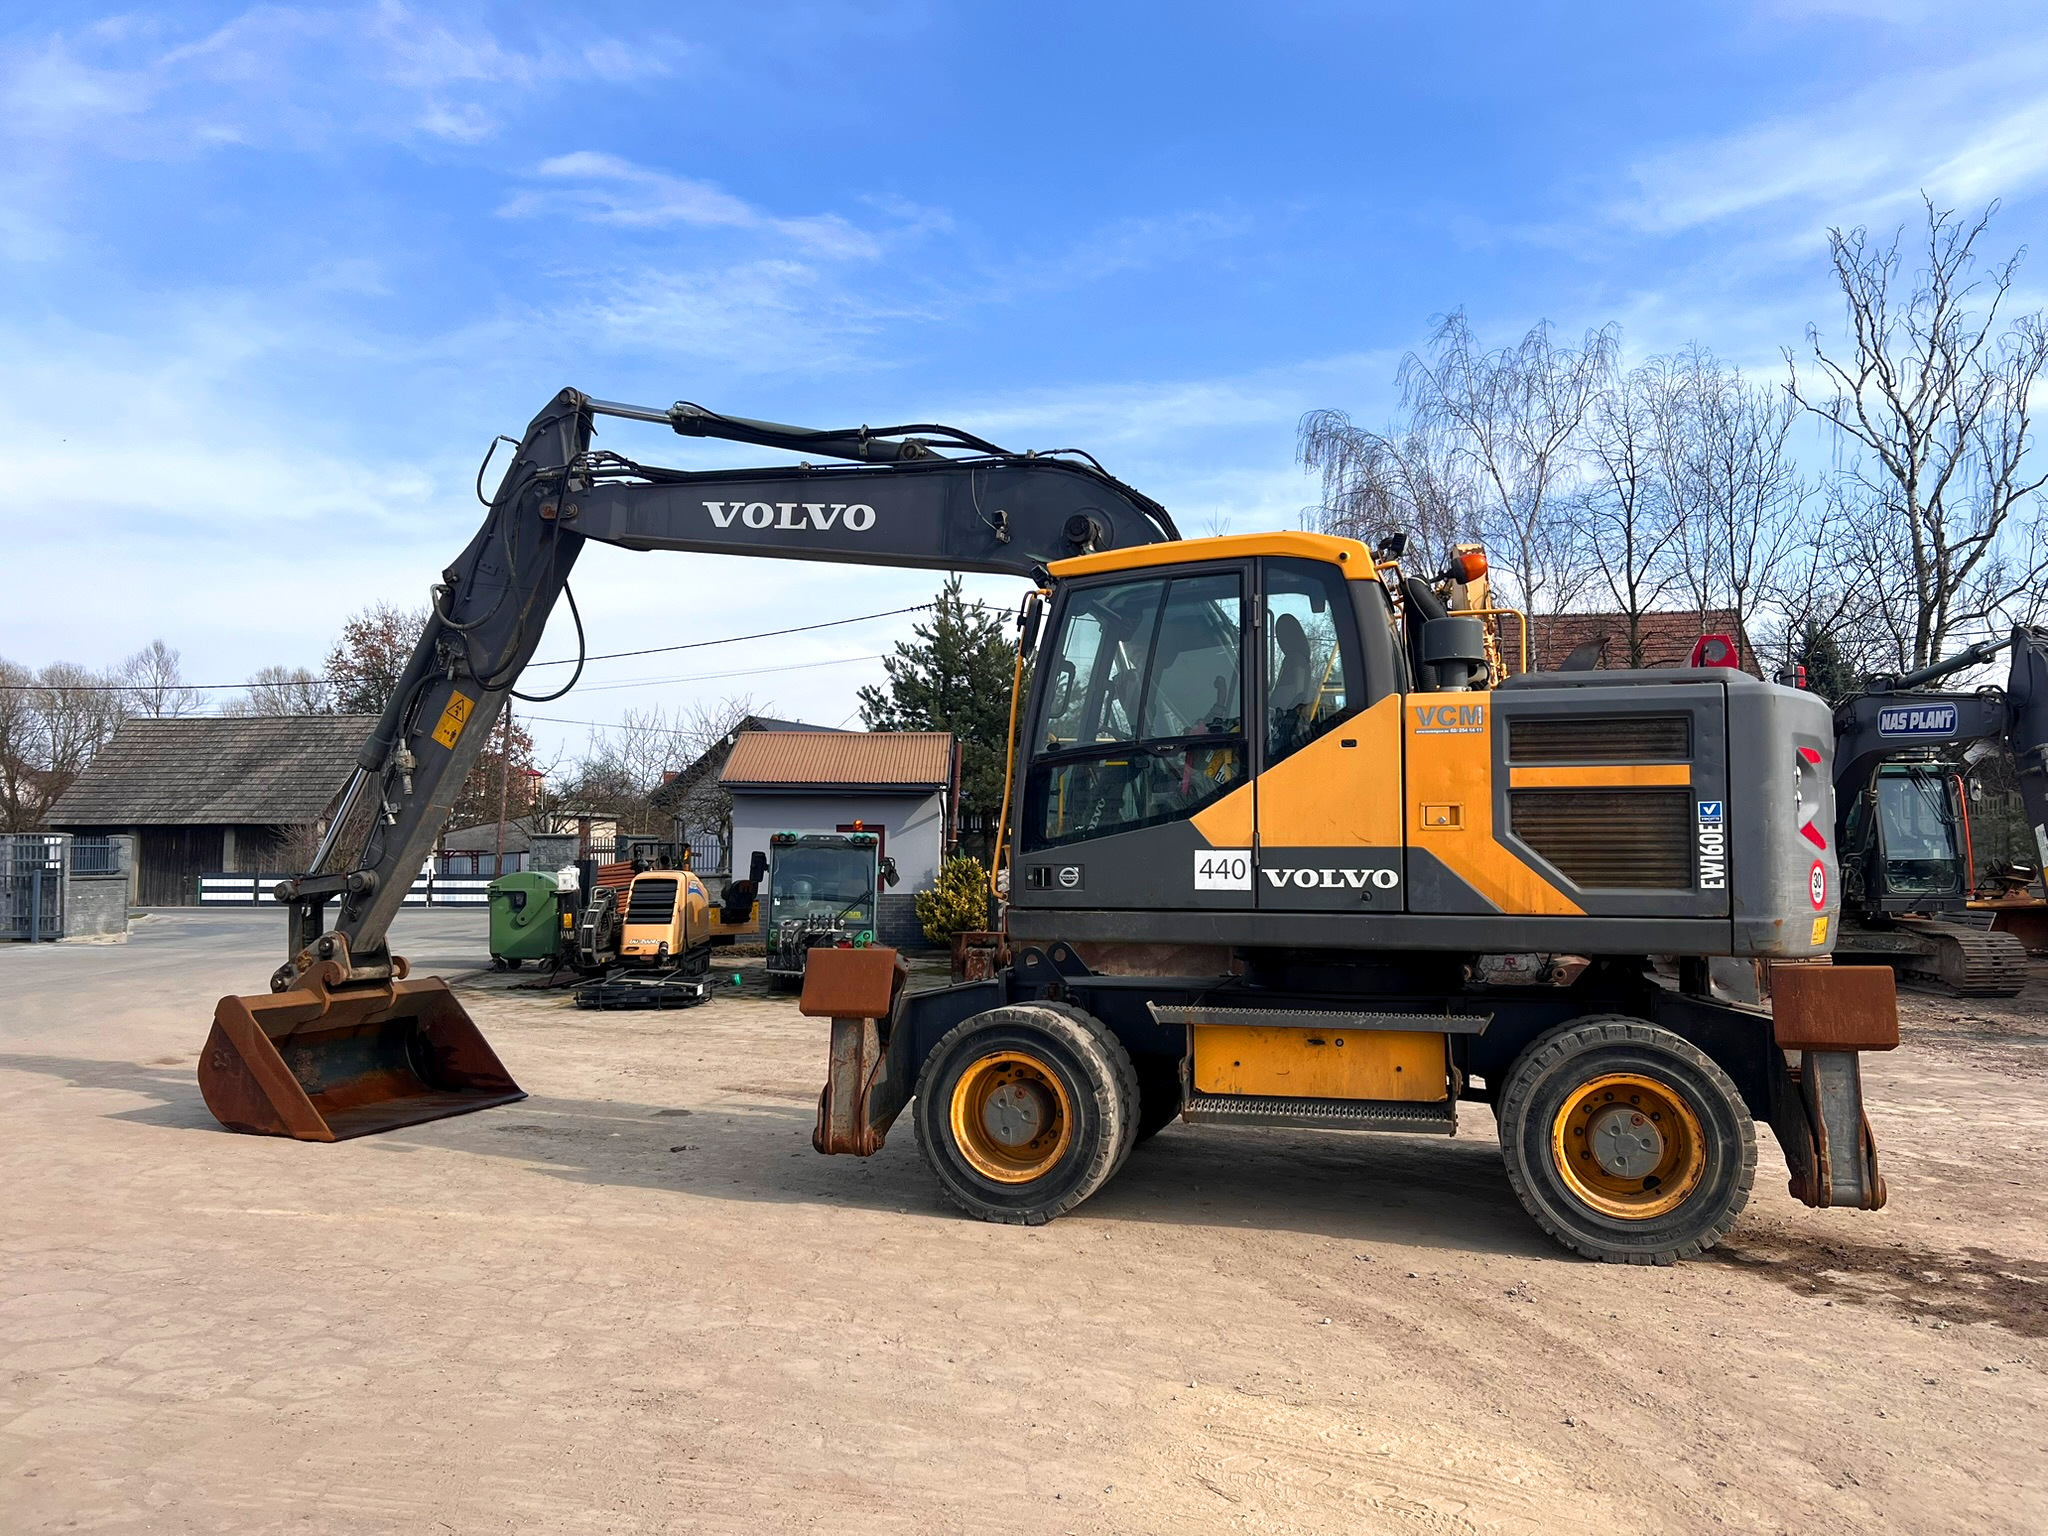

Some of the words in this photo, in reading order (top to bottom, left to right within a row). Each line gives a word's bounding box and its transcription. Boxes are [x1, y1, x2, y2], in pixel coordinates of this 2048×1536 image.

[702, 502, 876, 531] VOLVO
[1415, 705, 1483, 727] VCM
[1881, 712, 1908, 731] NAS
[1909, 709, 1954, 730] PLANT
[1699, 823, 1725, 889] EW160E
[1199, 858, 1246, 880] 440
[1262, 868, 1399, 889] VOLVO
[1813, 872, 1822, 889] 30
